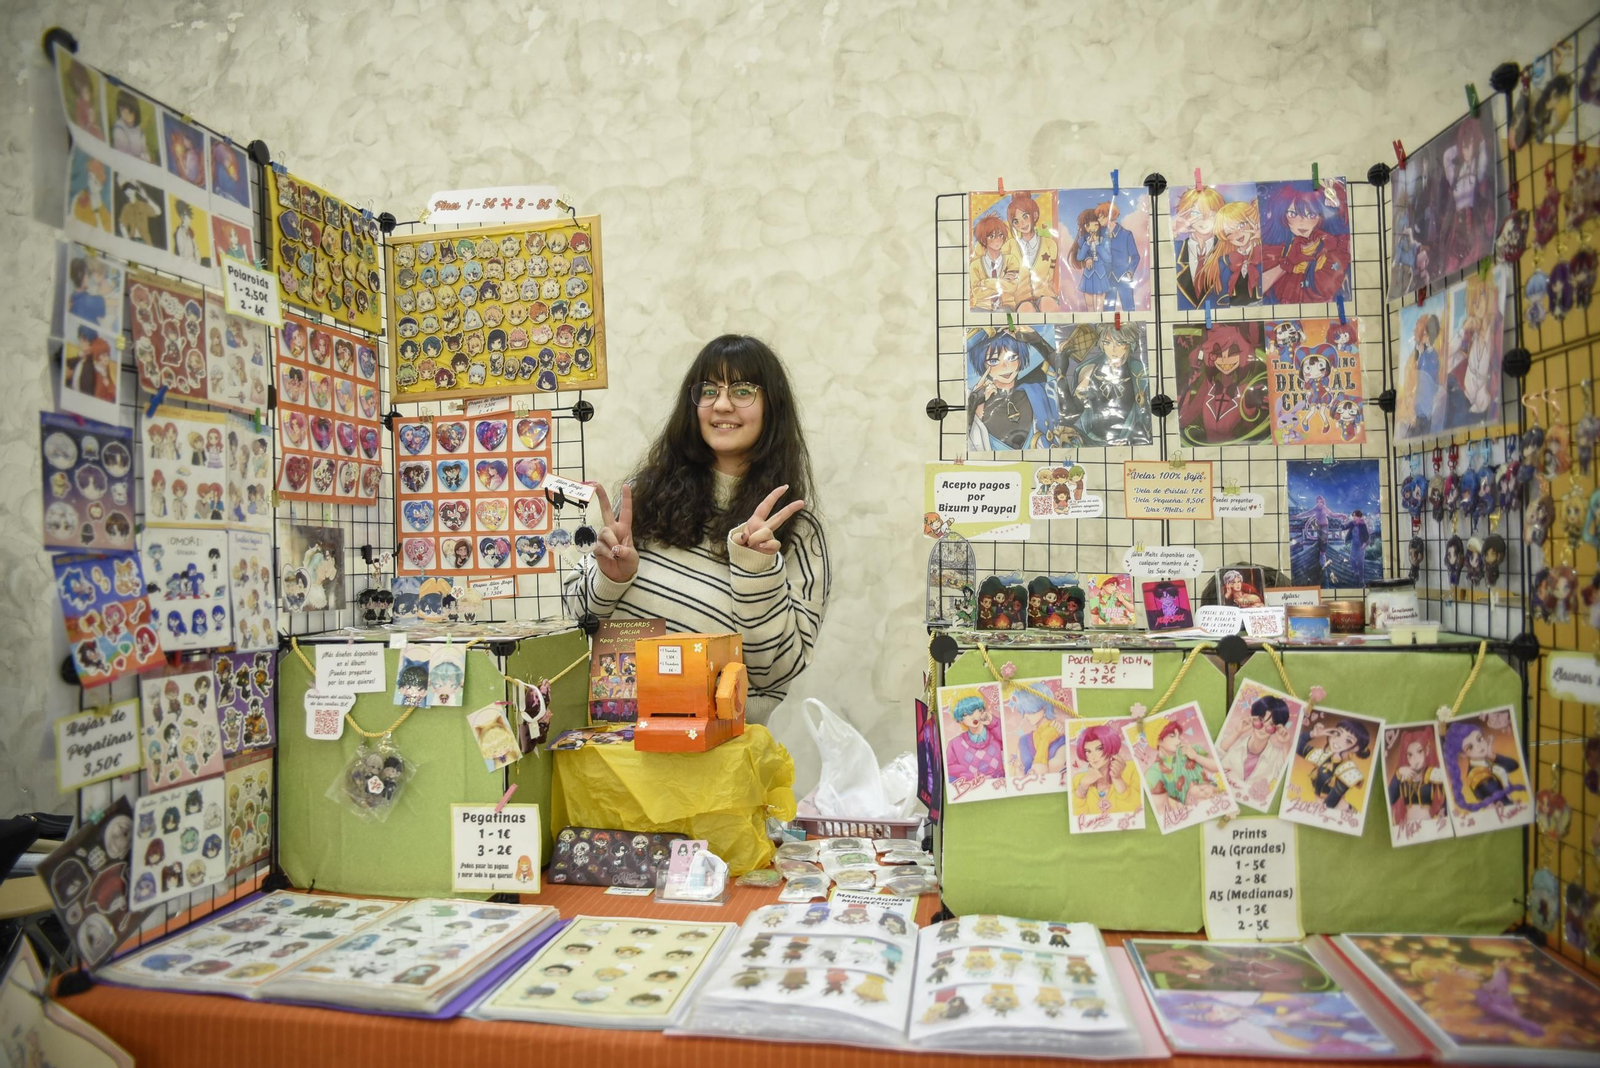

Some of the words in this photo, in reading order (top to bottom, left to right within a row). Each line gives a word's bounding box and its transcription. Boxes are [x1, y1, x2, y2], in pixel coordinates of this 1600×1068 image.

[466, 199, 474, 210] 1
[482, 197, 498, 210] 5€
[516, 198, 526, 210] 2
[228, 265, 269, 290] Polaroids
[233, 282, 238, 292] 1
[245, 287, 268, 303] 2,50€
[240, 300, 246, 310] 2
[254, 304, 265, 316] 4€
[1275, 371, 1356, 392] DIAL
[1132, 472, 1156, 480] Velas
[1160, 472, 1180, 480] 100%
[1184, 473, 1203, 482] Soja
[942, 480, 976, 490] Acepto
[980, 482, 1010, 492] pagos
[968, 494, 985, 502] por
[938, 502, 970, 512] Bizum
[972, 506, 978, 514] y
[982, 504, 1016, 514] Paypal
[336, 650, 352, 658] diseños
[354, 650, 378, 659] disponibles
[1122, 656, 1142, 664] KDH
[1103, 665, 1116, 674] 3€
[1079, 676, 1086, 684] 2
[1101, 675, 1116, 684] 5€
[66, 717, 105, 737] Hojas
[110, 710, 126, 724] de
[67, 731, 134, 761] Pegatinas
[83, 752, 122, 778] 3,50€
[462, 812, 526, 826] Pegatinas
[479, 829, 484, 839] 1
[498, 829, 511, 839] 1€
[1232, 828, 1267, 840] Prints
[478, 845, 484, 856] 3
[497, 845, 512, 855] 2€
[1211, 845, 1226, 857] A4
[1230, 842, 1286, 856] (Grandes)
[1236, 860, 1241, 869] 1
[1253, 859, 1266, 871] 5€
[1235, 875, 1242, 885] 2
[1254, 874, 1267, 884] 8€
[1209, 891, 1224, 901] A5
[1227, 888, 1293, 901] (Medianas)
[1237, 905, 1241, 914] 1
[1254, 904, 1267, 915] 3€
[1238, 920, 1245, 930] 2
[1256, 920, 1269, 931] 5€
